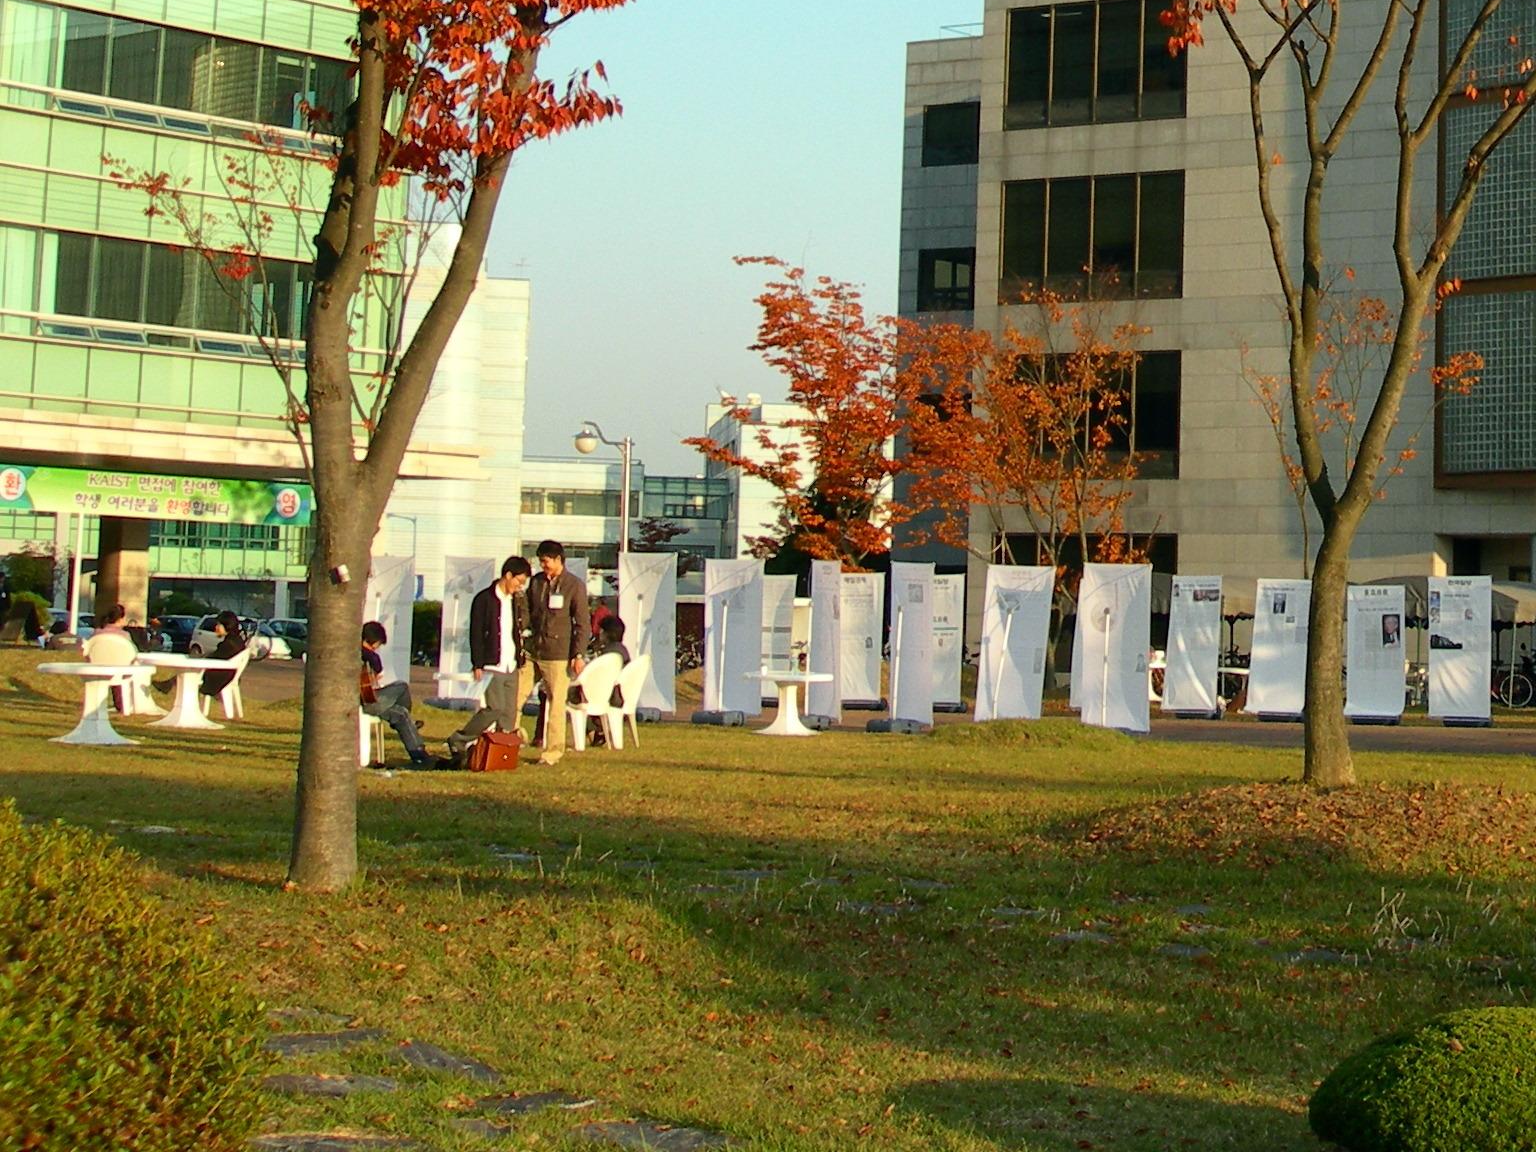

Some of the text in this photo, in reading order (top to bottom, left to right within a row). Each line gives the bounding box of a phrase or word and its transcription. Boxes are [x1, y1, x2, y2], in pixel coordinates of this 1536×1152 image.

[4, 472, 20, 496] 환
[89, 474, 221, 496] KAIST 면접에 참여한
[75, 493, 230, 516] 학생 여러분을 환영합니다
[282, 493, 296, 515] 영
